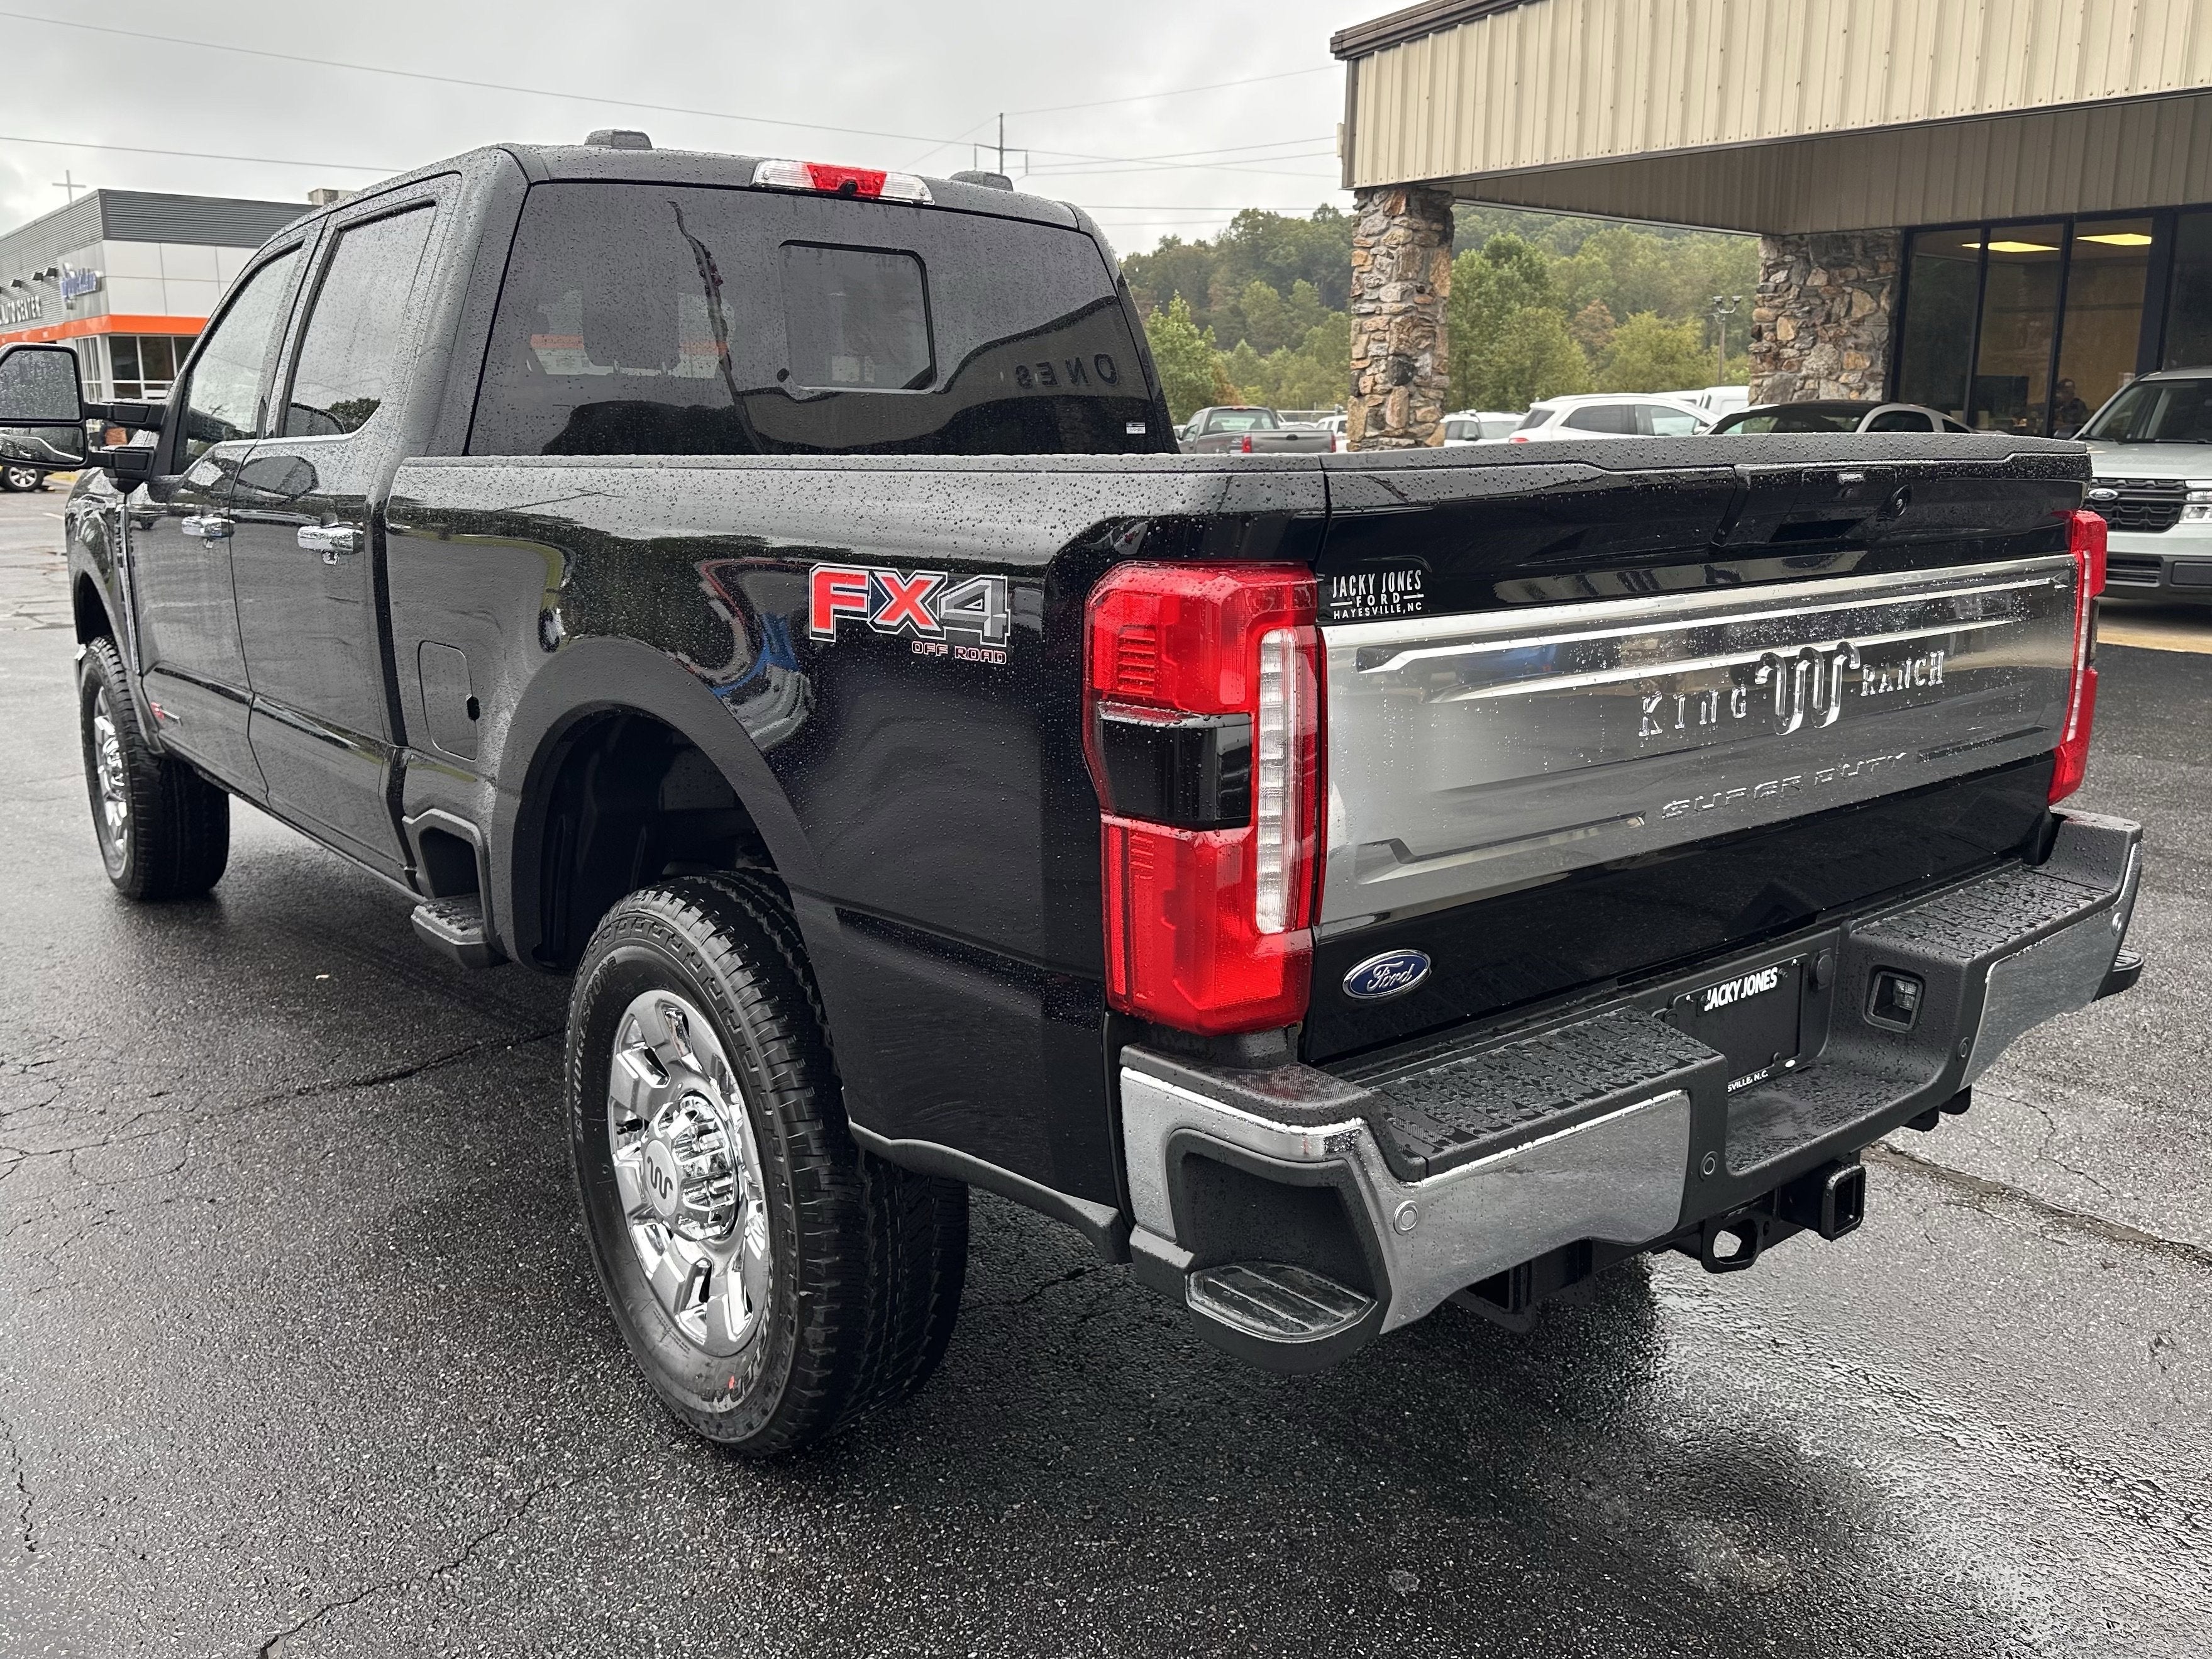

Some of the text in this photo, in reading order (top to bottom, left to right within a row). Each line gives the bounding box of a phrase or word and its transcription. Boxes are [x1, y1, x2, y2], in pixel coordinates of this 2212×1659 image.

[1332, 569, 1422, 598] JACKY JONES
[1356, 592, 1400, 608] FORD
[809, 563, 1010, 647] FX4
[911, 640, 1007, 665] OFF ROAD
[1638, 650, 1945, 738] KING RANCH
[1661, 752, 1907, 820] SUPER DUTY
[1366, 960, 1415, 992] Ford
[1704, 967, 1778, 1012] JACKY JONES
[573, 956, 618, 1144] BRIDGESTONE
[1727, 1070, 1769, 1092] SVILLE, N.C.
